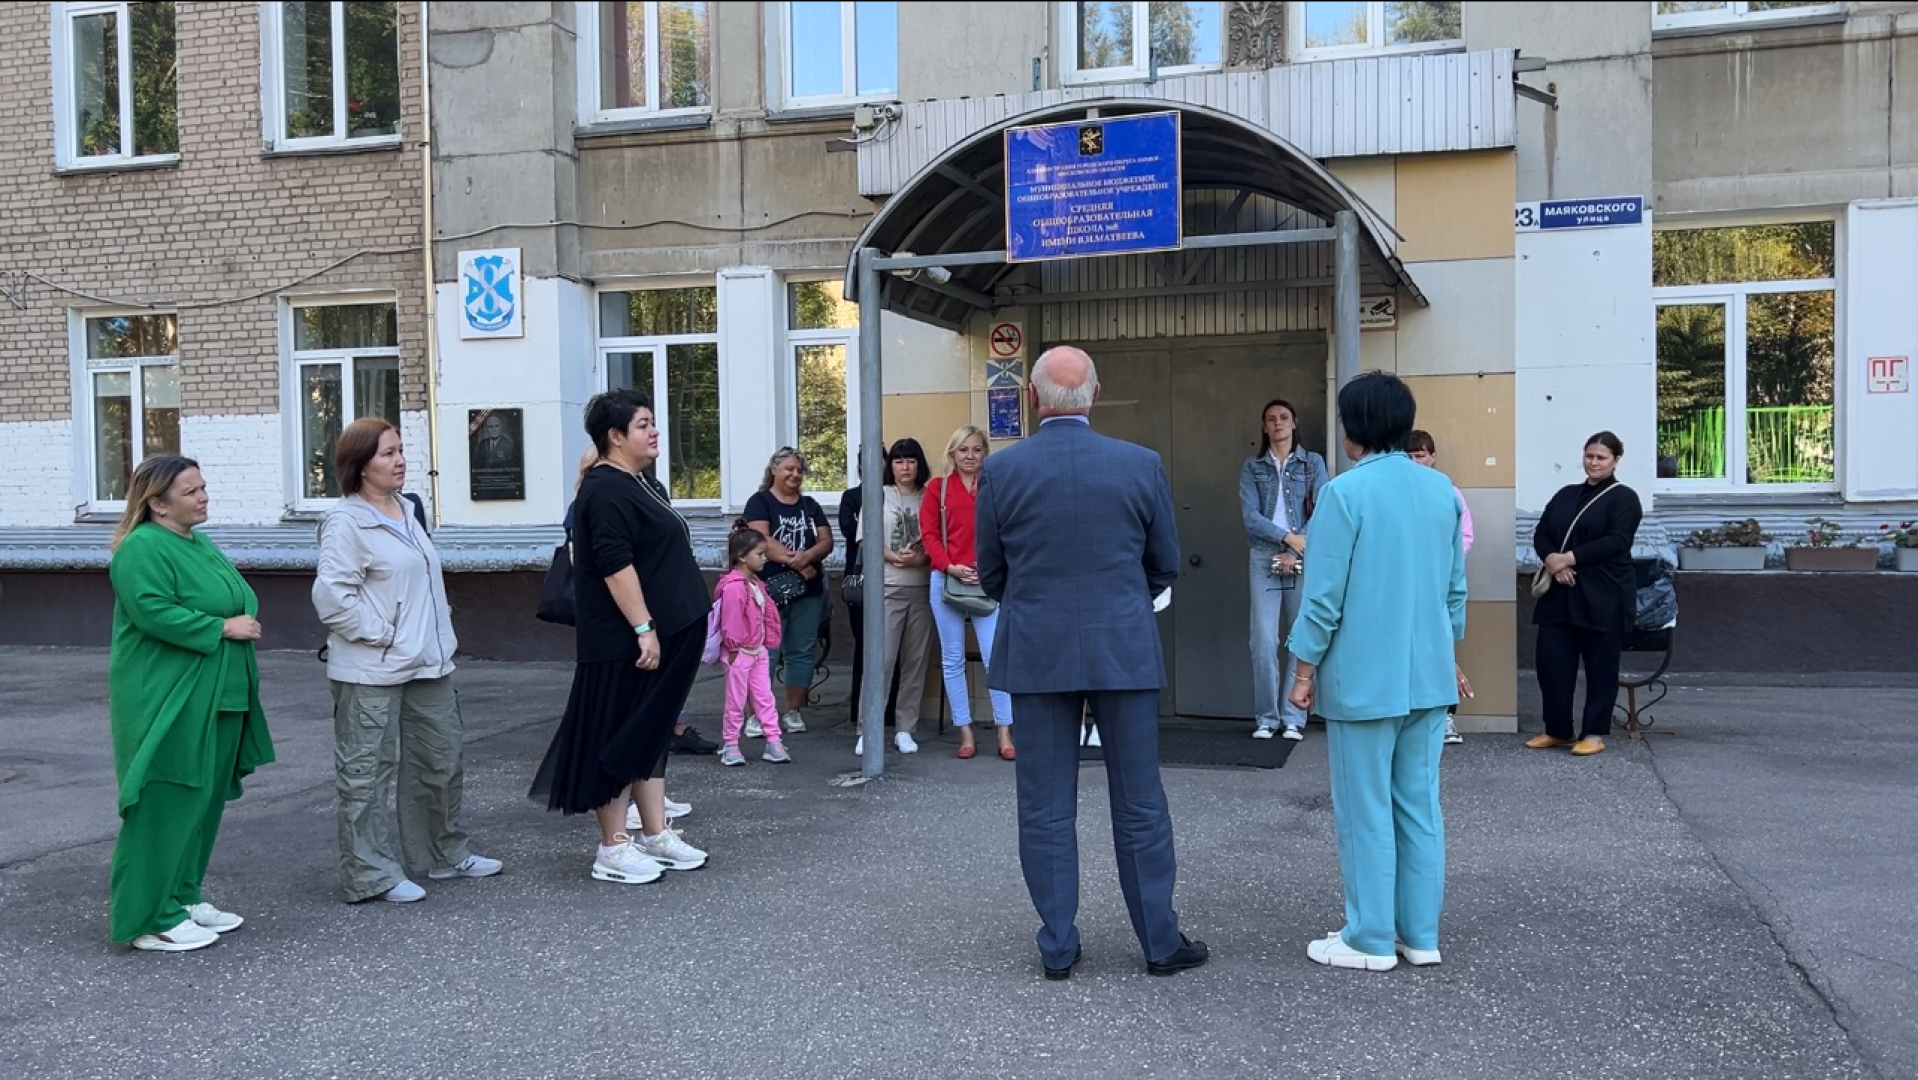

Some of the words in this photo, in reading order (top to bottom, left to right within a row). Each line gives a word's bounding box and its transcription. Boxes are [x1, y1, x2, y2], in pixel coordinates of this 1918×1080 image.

[1030, 180, 1102, 193] МУНИЦИПАЛЬНОЕ
[1103, 174, 1156, 187] БЮДЖЕТНОЕ
[1115, 181, 1169, 196] УЧРЕЖДЕНИЕ
[1070, 201, 1114, 213] СРЕДНЯЯ
[1545, 202, 1637, 216] МАЯКОВСКОГО
[1033, 208, 1154, 228] ОБЩЕОБРАЗОВАТЕЛЬНАЯ
[1576, 215, 1610, 225] улица
[1066, 223, 1104, 235] ШКОЛА
[1041, 236, 1077, 248] ИМЕНИ
[1873, 359, 1904, 377] ПГ
